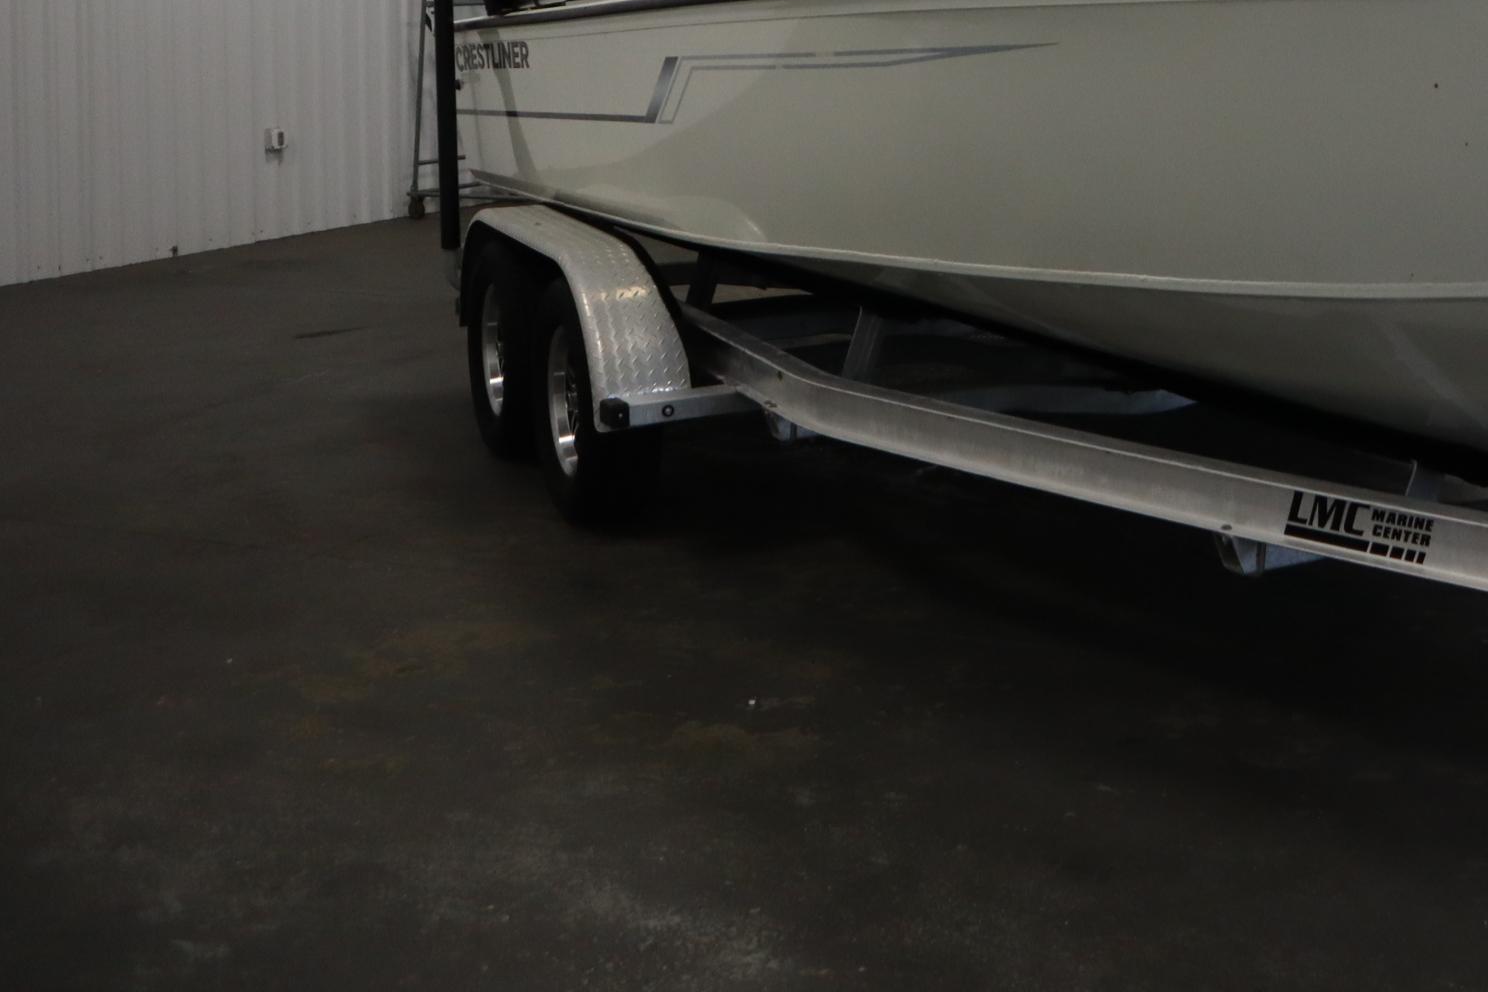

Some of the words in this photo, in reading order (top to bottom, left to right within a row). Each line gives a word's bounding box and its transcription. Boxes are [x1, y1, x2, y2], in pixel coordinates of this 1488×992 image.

[455, 40, 530, 72] CRESTLINER
[1288, 490, 1371, 537] LMC
[1371, 508, 1435, 533] MARINE
[1372, 524, 1432, 547] CENTER
